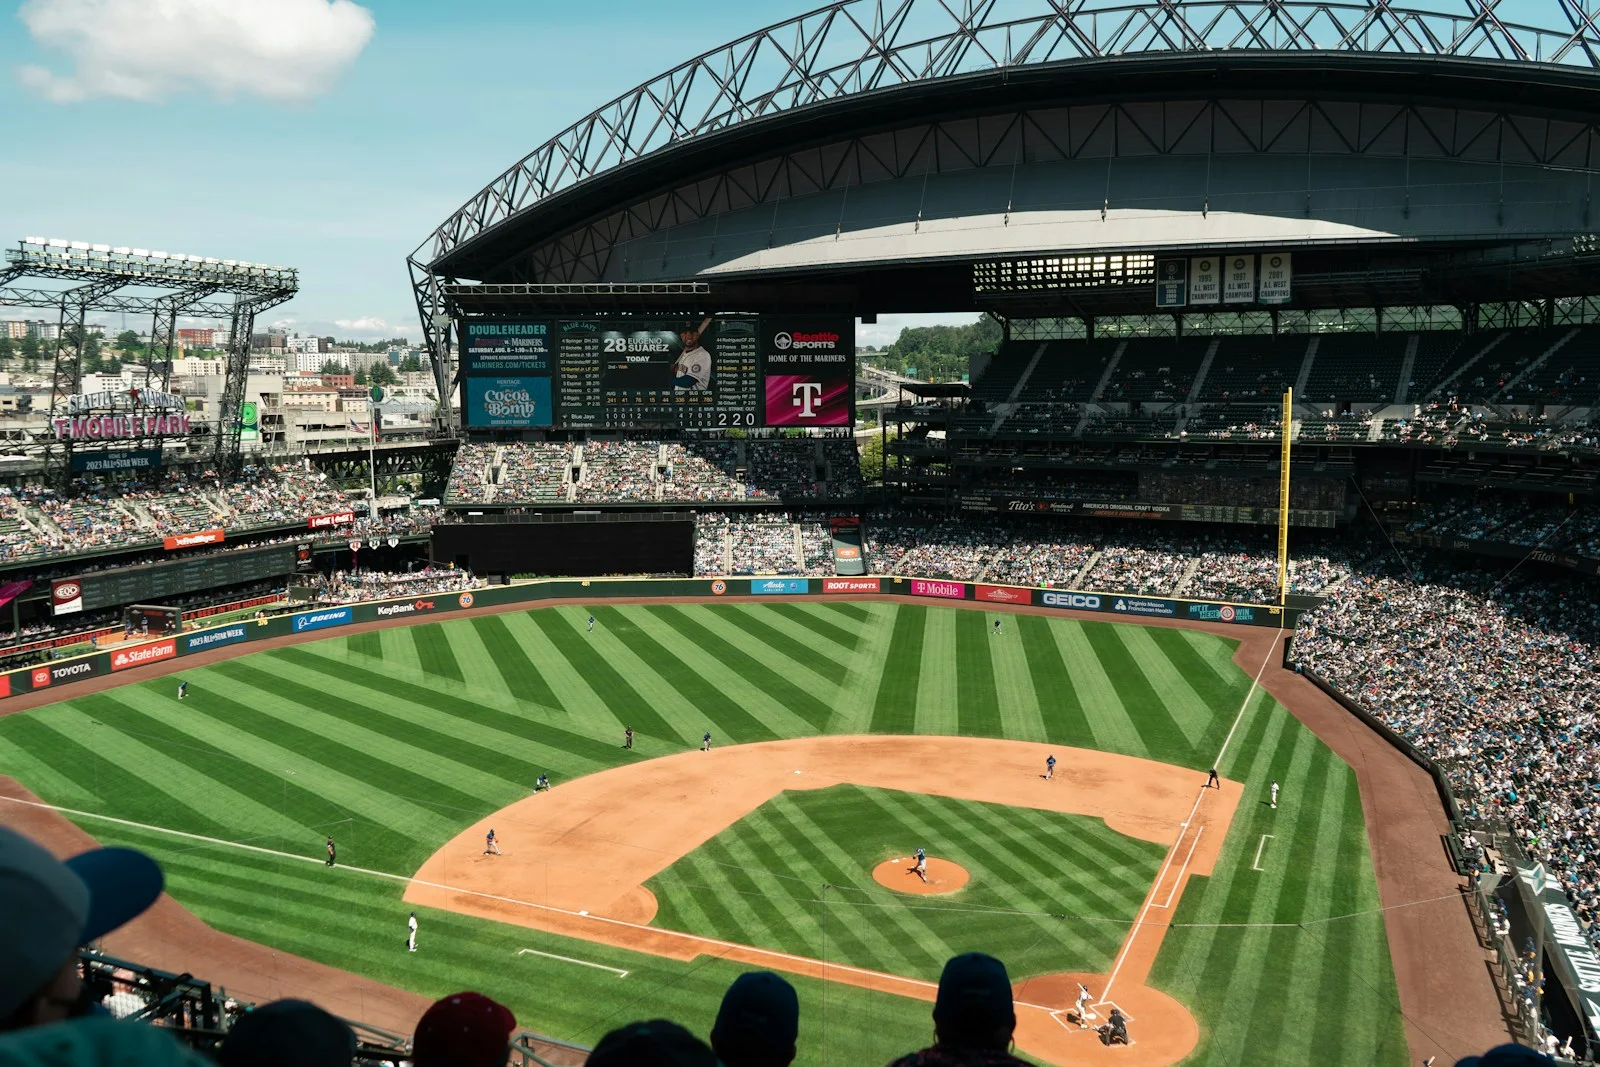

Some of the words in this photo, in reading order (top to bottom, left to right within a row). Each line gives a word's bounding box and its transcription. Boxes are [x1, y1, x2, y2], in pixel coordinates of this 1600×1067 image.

[469, 325, 546, 335] DOUBLEHEADER
[562, 322, 580, 332] BLUE
[580, 322, 596, 332] JAYS
[792, 332, 839, 341] Seattle
[604, 338, 627, 352] 28
[70, 390, 114, 413] SEATTLE
[484, 390, 530, 403] Cocoa
[793, 383, 821, 417] T
[488, 402, 535, 418] Bomb
[718, 413, 727, 425] 2
[732, 413, 741, 425] 2
[746, 413, 755, 425] 0
[55, 416, 143, 438] T-MOBILE
[145, 415, 190, 436] PARK
[86, 461, 102, 470] 2023
[132, 458, 149, 467] WEEK
[1008, 500, 1035, 511] Tito's
[1454, 540, 1469, 550] MPH
[1531, 550, 1556, 562] Tito's
[927, 583, 958, 596] Mobile
[1043, 592, 1100, 608] GEICO
[378, 603, 415, 615] KeyBank
[310, 611, 346, 623] BOEING
[190, 639, 203, 647] 2023
[226, 628, 244, 638] WEEK
[34, 641, 52, 649] THE
[129, 649, 151, 662] State
[152, 645, 173, 657] Farm
[53, 663, 91, 678] TOYOTA
[1543, 903, 1590, 949] MARINERS
